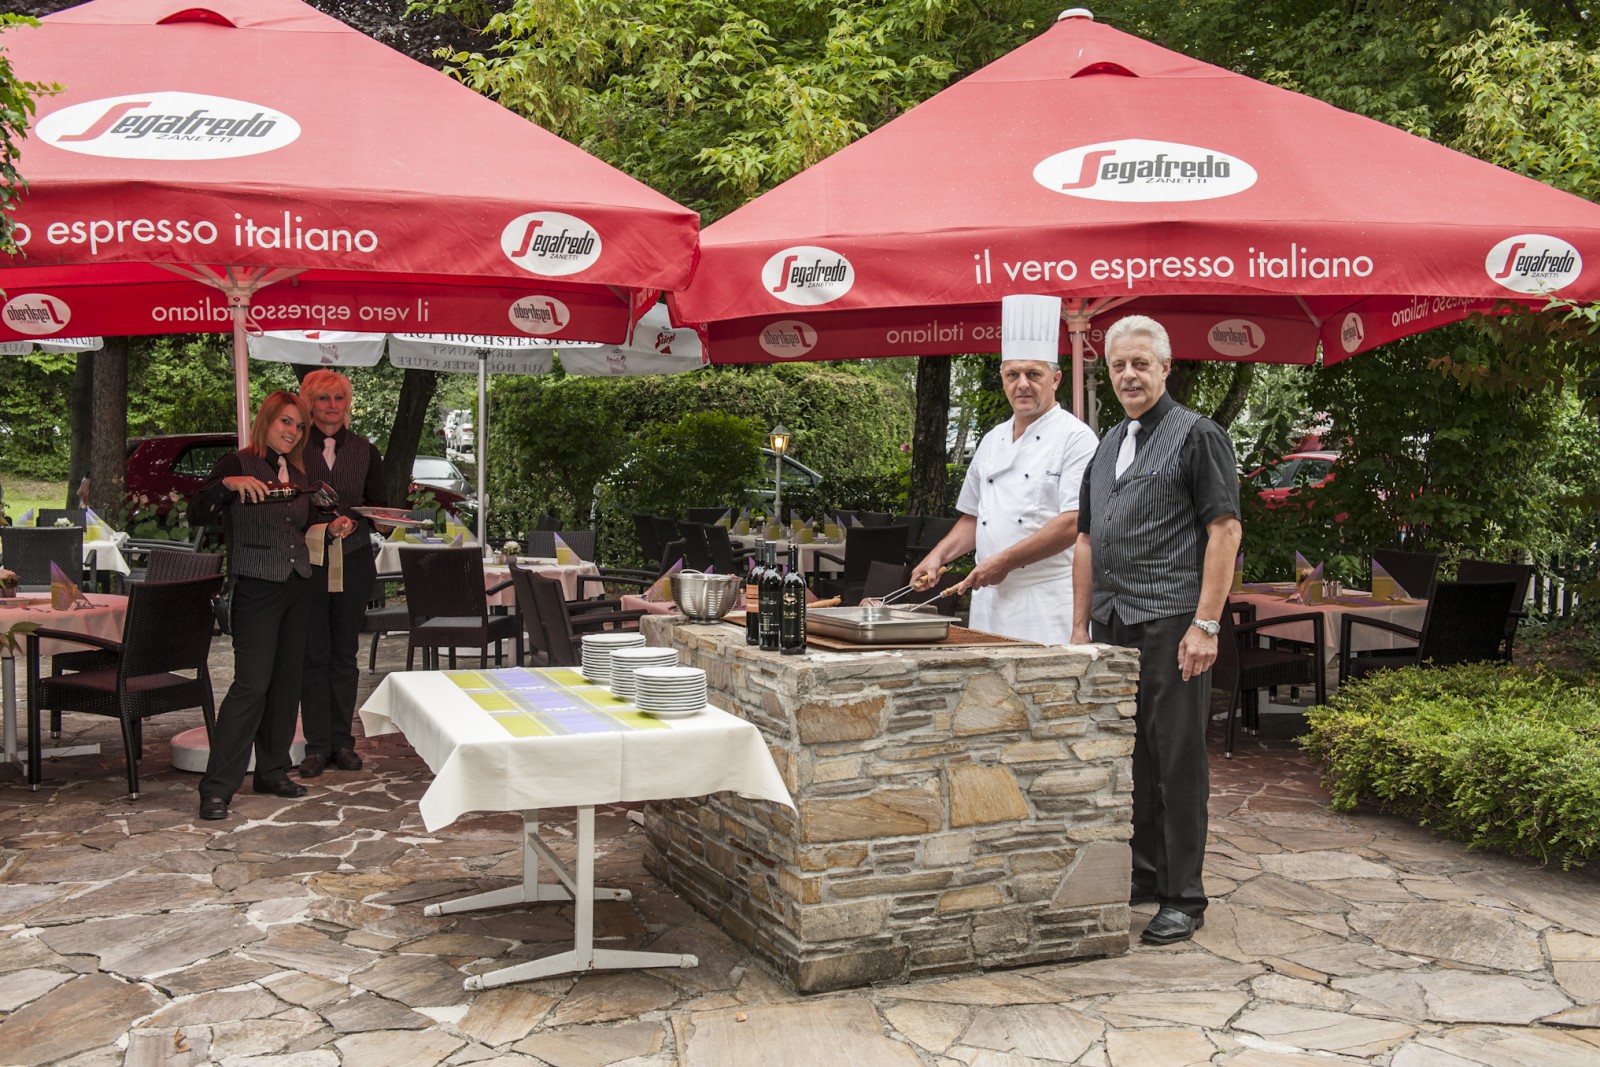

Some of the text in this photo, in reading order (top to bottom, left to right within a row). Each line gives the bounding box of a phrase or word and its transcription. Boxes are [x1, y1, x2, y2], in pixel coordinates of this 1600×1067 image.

[56, 101, 277, 141] Segafredo
[156, 133, 234, 143] ZANETTI
[1062, 149, 1231, 190] Segafredo
[46, 219, 218, 254] espresso
[235, 211, 379, 253] italiano
[511, 219, 595, 258] Segafredo
[549, 252, 579, 261] ZANETTI
[773, 255, 847, 293] Segafredo
[974, 242, 1374, 289] il vero espresso italiano
[1495, 242, 1575, 278] Segafredo
